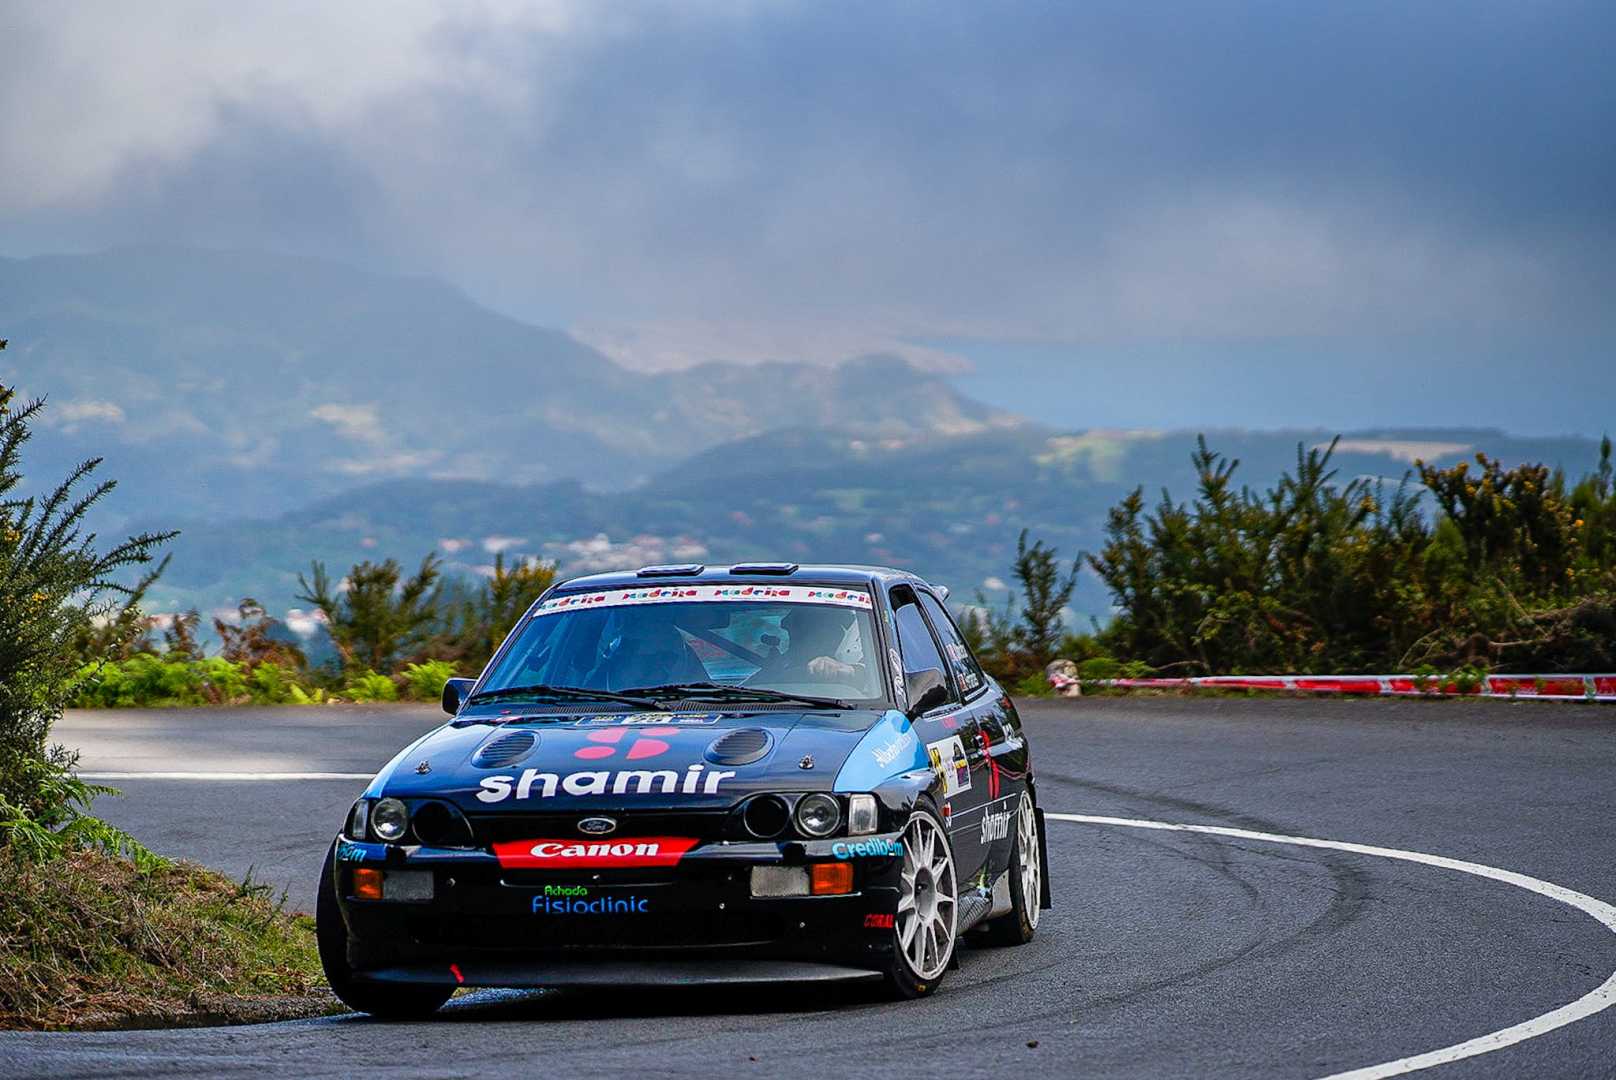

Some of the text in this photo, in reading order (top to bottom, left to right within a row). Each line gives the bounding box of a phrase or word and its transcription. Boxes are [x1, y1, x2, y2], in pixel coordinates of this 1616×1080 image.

[475, 764, 736, 803] shamir
[530, 843, 658, 857] Canon
[832, 838, 904, 859] Credibom
